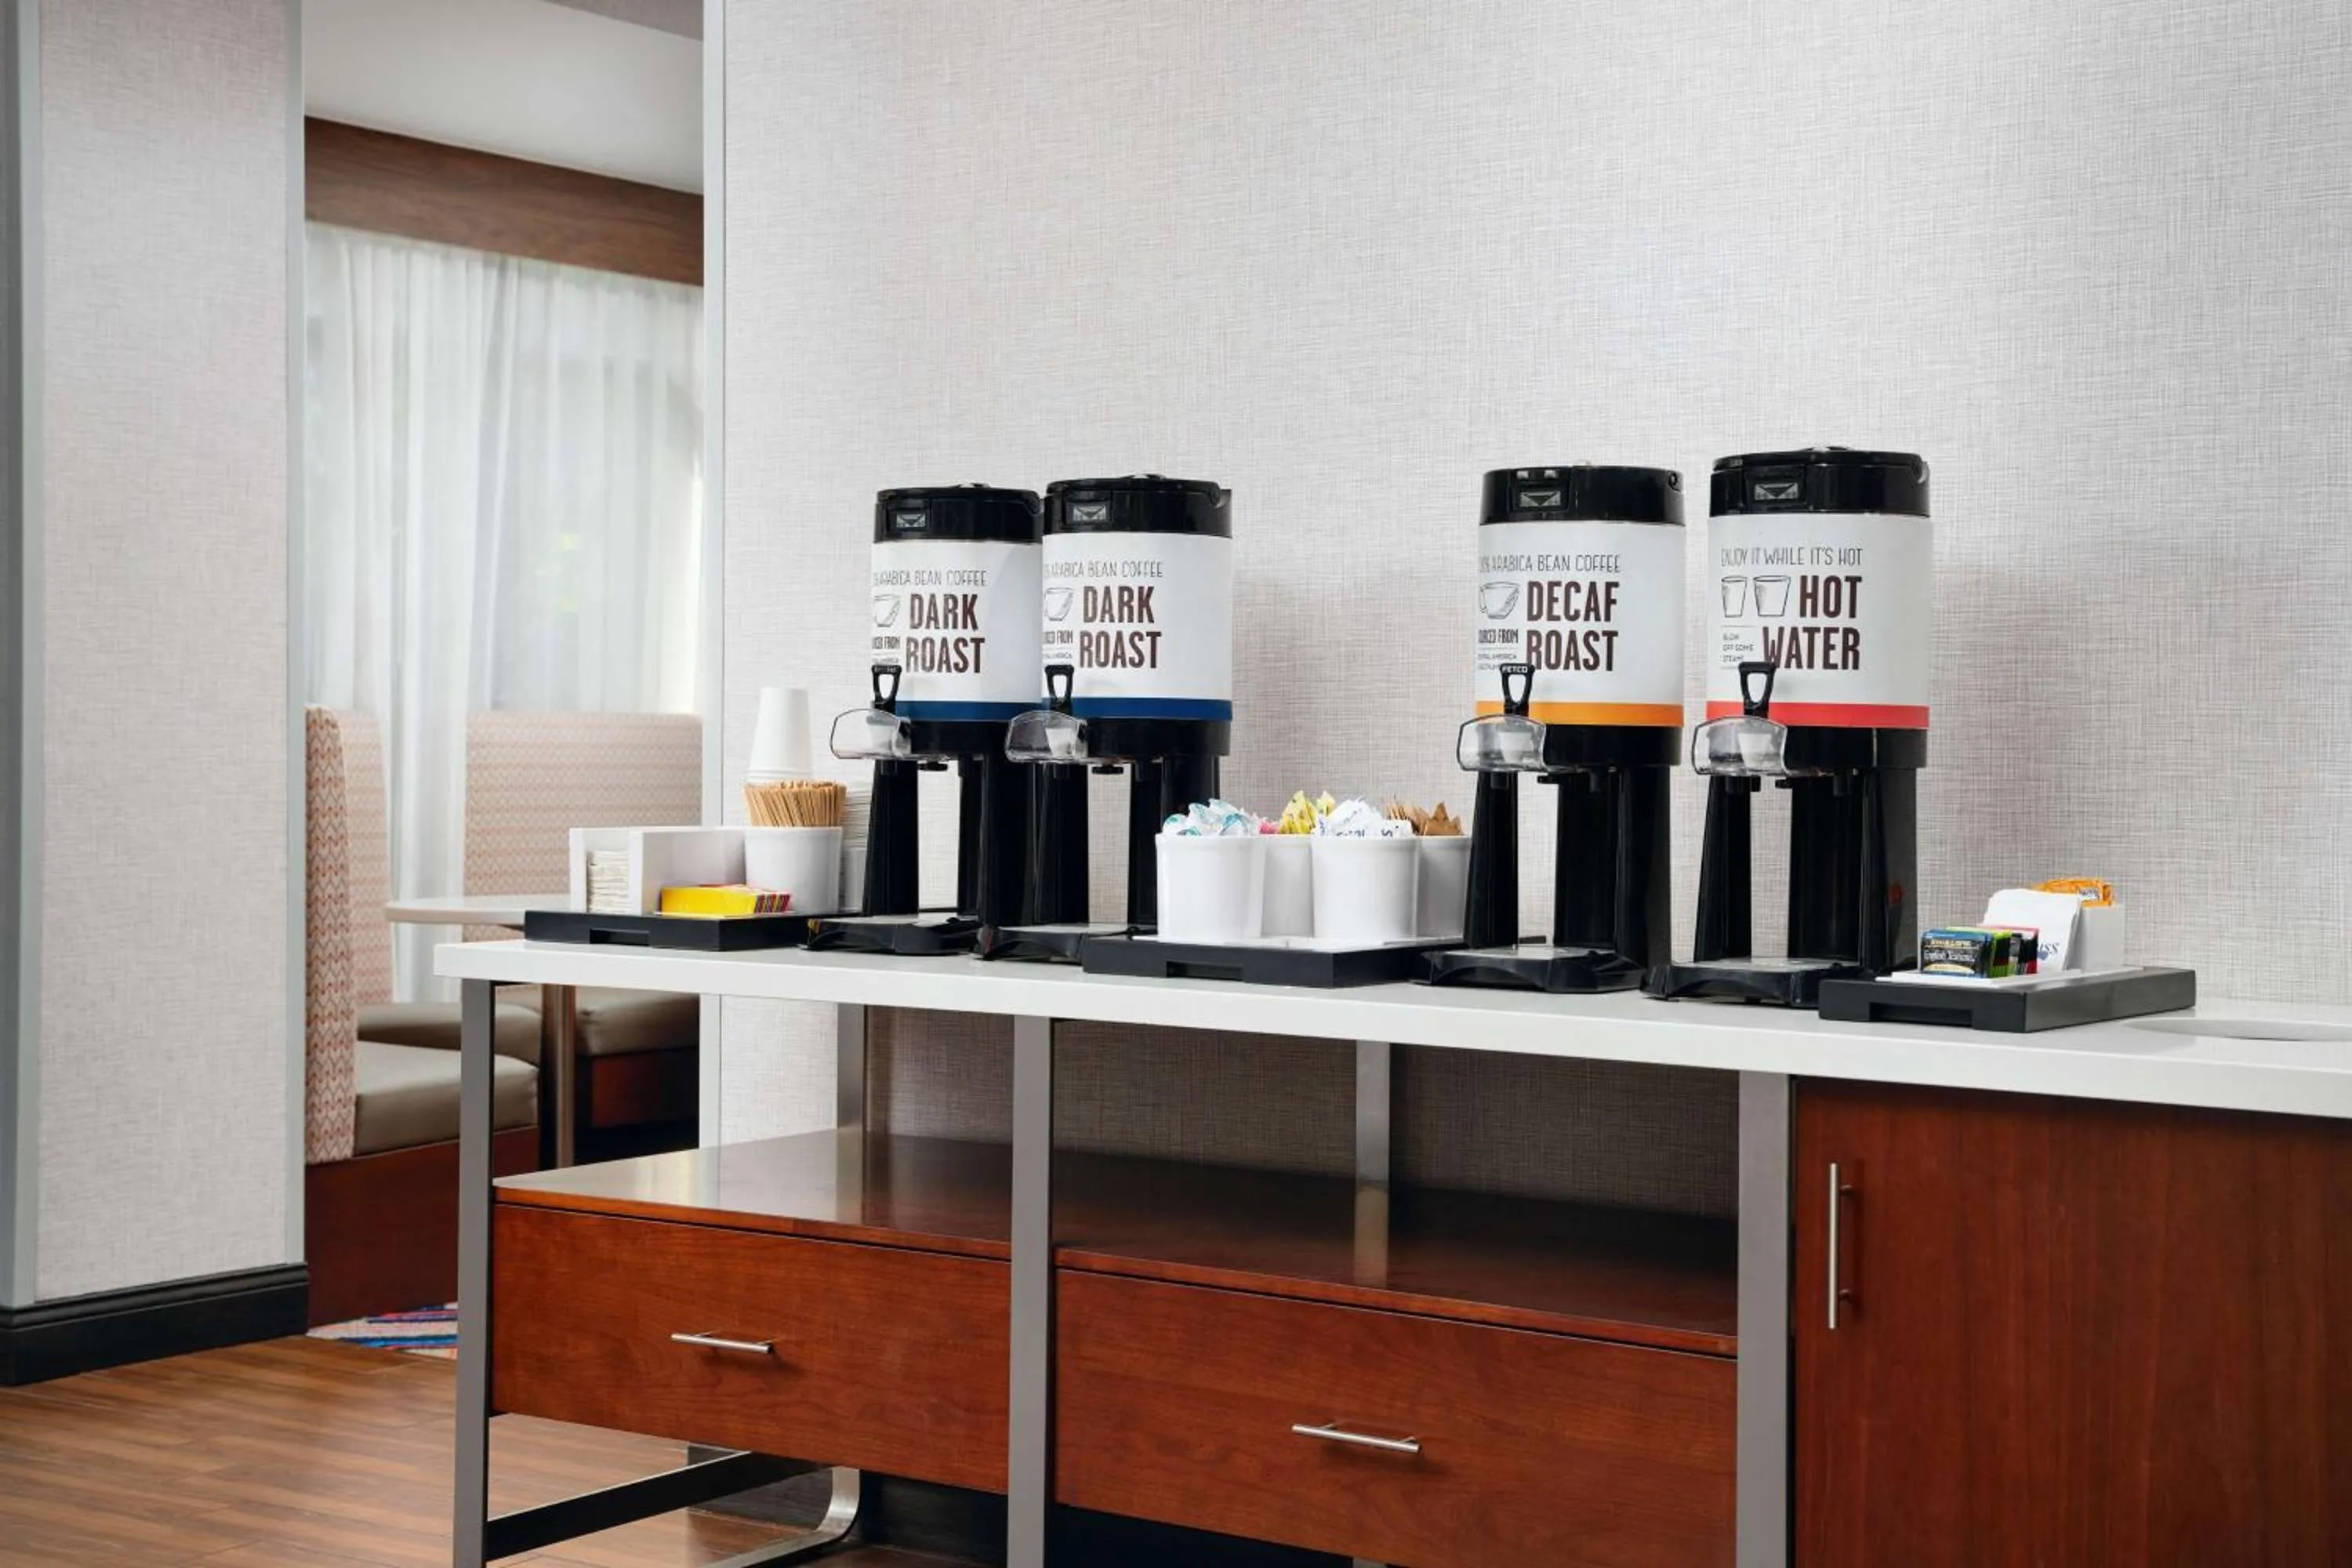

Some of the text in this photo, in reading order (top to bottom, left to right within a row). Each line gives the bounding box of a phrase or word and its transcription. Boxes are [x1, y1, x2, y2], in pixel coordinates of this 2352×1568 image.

[1087, 561, 1117, 578] BEAN
[1121, 561, 1163, 578] COFFEE
[1491, 554, 1533, 572] ARABICA
[1537, 554, 1570, 572] BEAN
[1575, 554, 1621, 572] COFFEE
[1720, 547, 1864, 566] ENJOY IT WHILE IT'S HOT
[914, 569, 942, 586] BEAN
[946, 569, 988, 586] COFFEE
[909, 593, 979, 630] DARK
[1083, 585, 1155, 623] DARK
[1526, 580, 1620, 622] DECAF
[1798, 575, 1863, 619] HOT
[905, 636, 985, 673] ROAST
[1079, 630, 1162, 669] ROAST
[1497, 629, 1519, 644] FROM
[1526, 630, 1619, 672] ROAST
[1762, 626, 1860, 670] WATER
